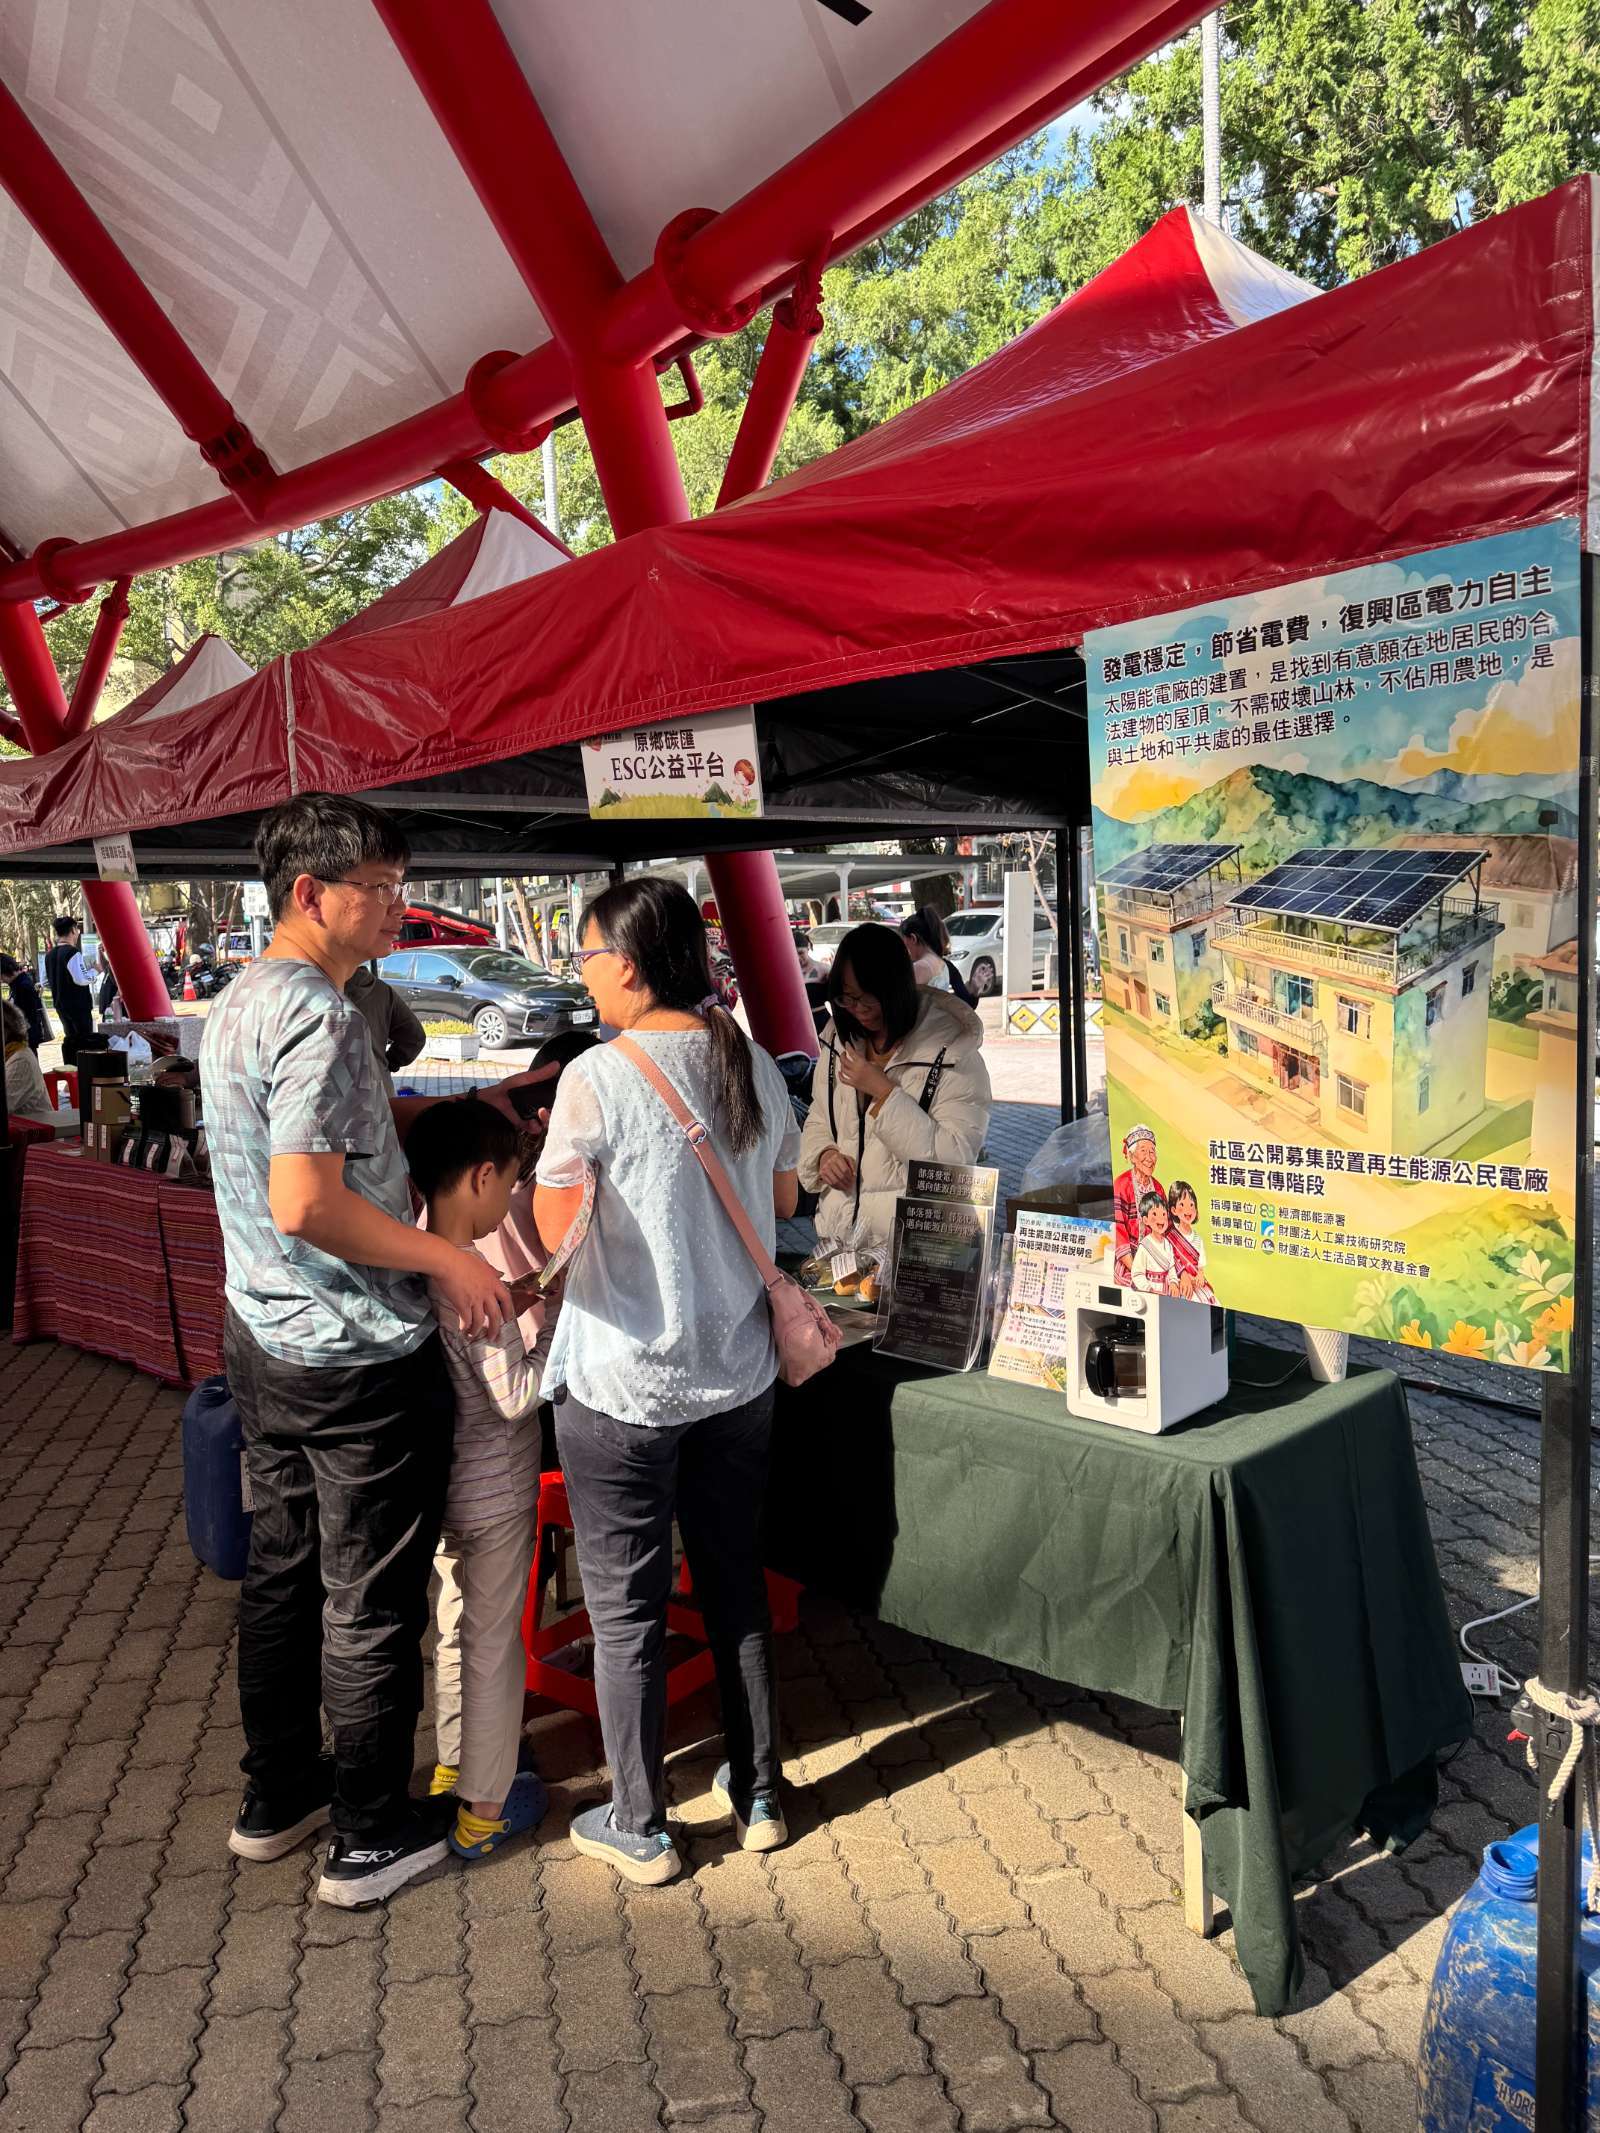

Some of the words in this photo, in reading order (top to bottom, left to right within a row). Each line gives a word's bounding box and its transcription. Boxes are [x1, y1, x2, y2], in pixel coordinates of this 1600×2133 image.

[1103, 564, 1552, 683] 發電穩定，節省電費，復興區電力自主
[1104, 610, 1554, 716] 太陽能電廠的建置，是找到有意願在地居民的合
[1106, 645, 1555, 742] 法建物的屋頂，不需破壞山林，不佔用農地，是
[633, 729, 695, 752] 原鄉碳匯
[1107, 711, 1352, 767] 與土地和平共處的最佳選擇。
[610, 751, 725, 781] ESG公益平台
[1209, 1140, 1549, 1193] 社區公開募集設置再生能源公民電廠
[1210, 1165, 1325, 1196] 推廣宣傳階段
[1278, 1207, 1346, 1228] 經濟部能源署
[1278, 1224, 1407, 1255] 財團法人工業技術研究院
[1278, 1242, 1431, 1278] 財團法人生活品質文教基金會
